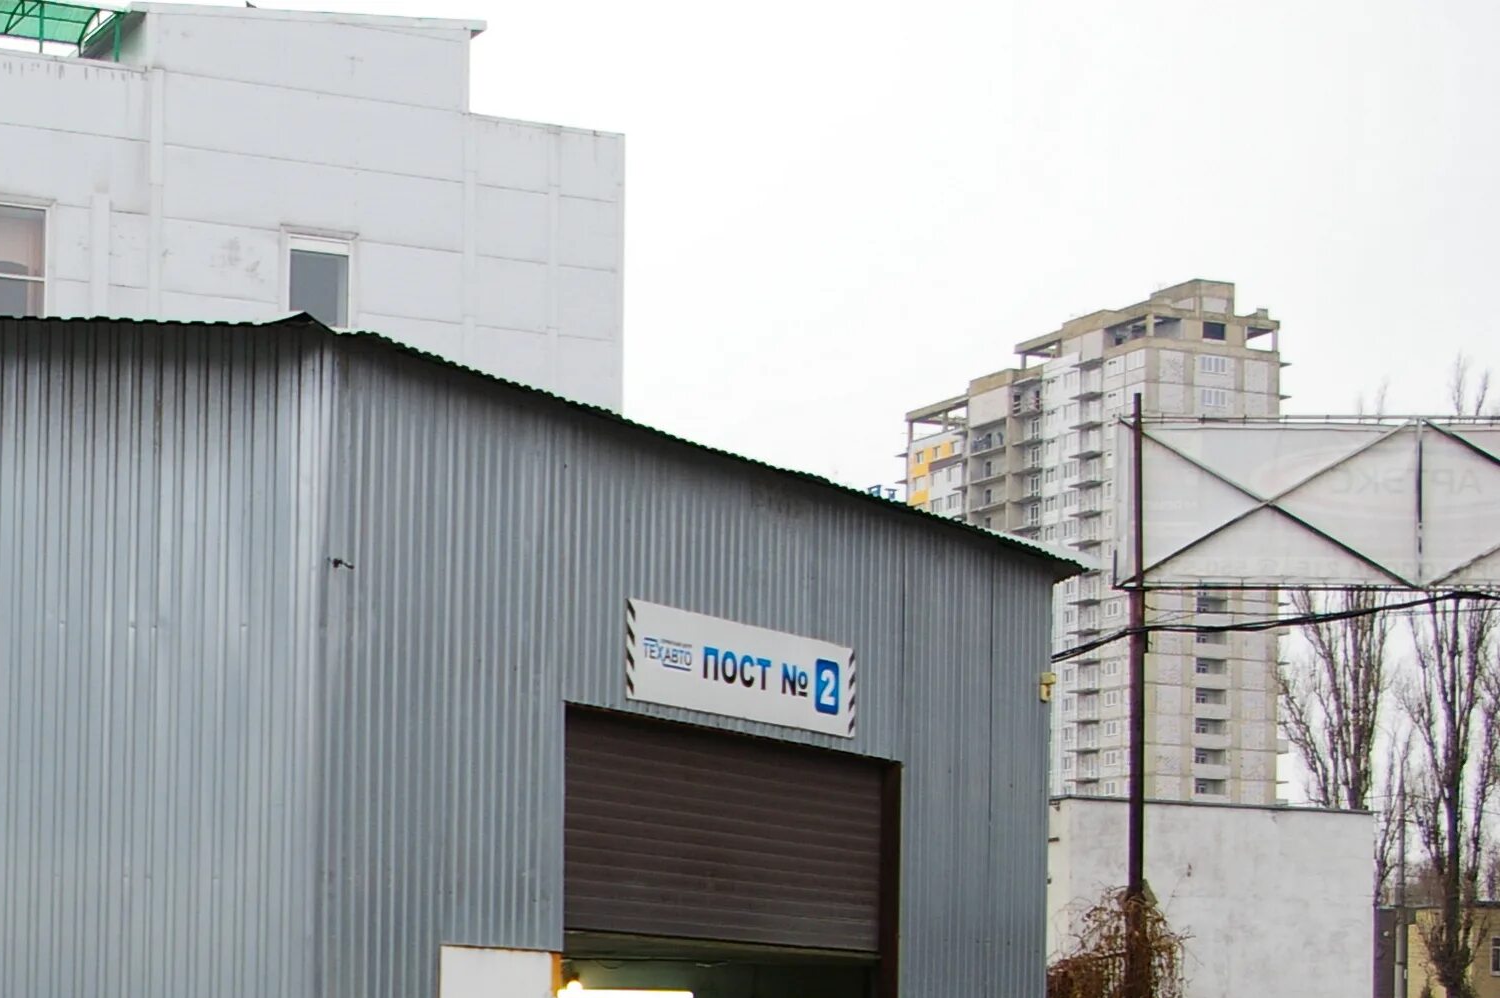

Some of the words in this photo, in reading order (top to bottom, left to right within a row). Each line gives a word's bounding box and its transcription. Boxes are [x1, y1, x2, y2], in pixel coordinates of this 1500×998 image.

[643, 642, 692, 666] ТЕХАВТО
[703, 646, 772, 690] ПОСТ
[819, 668, 836, 706] 2
